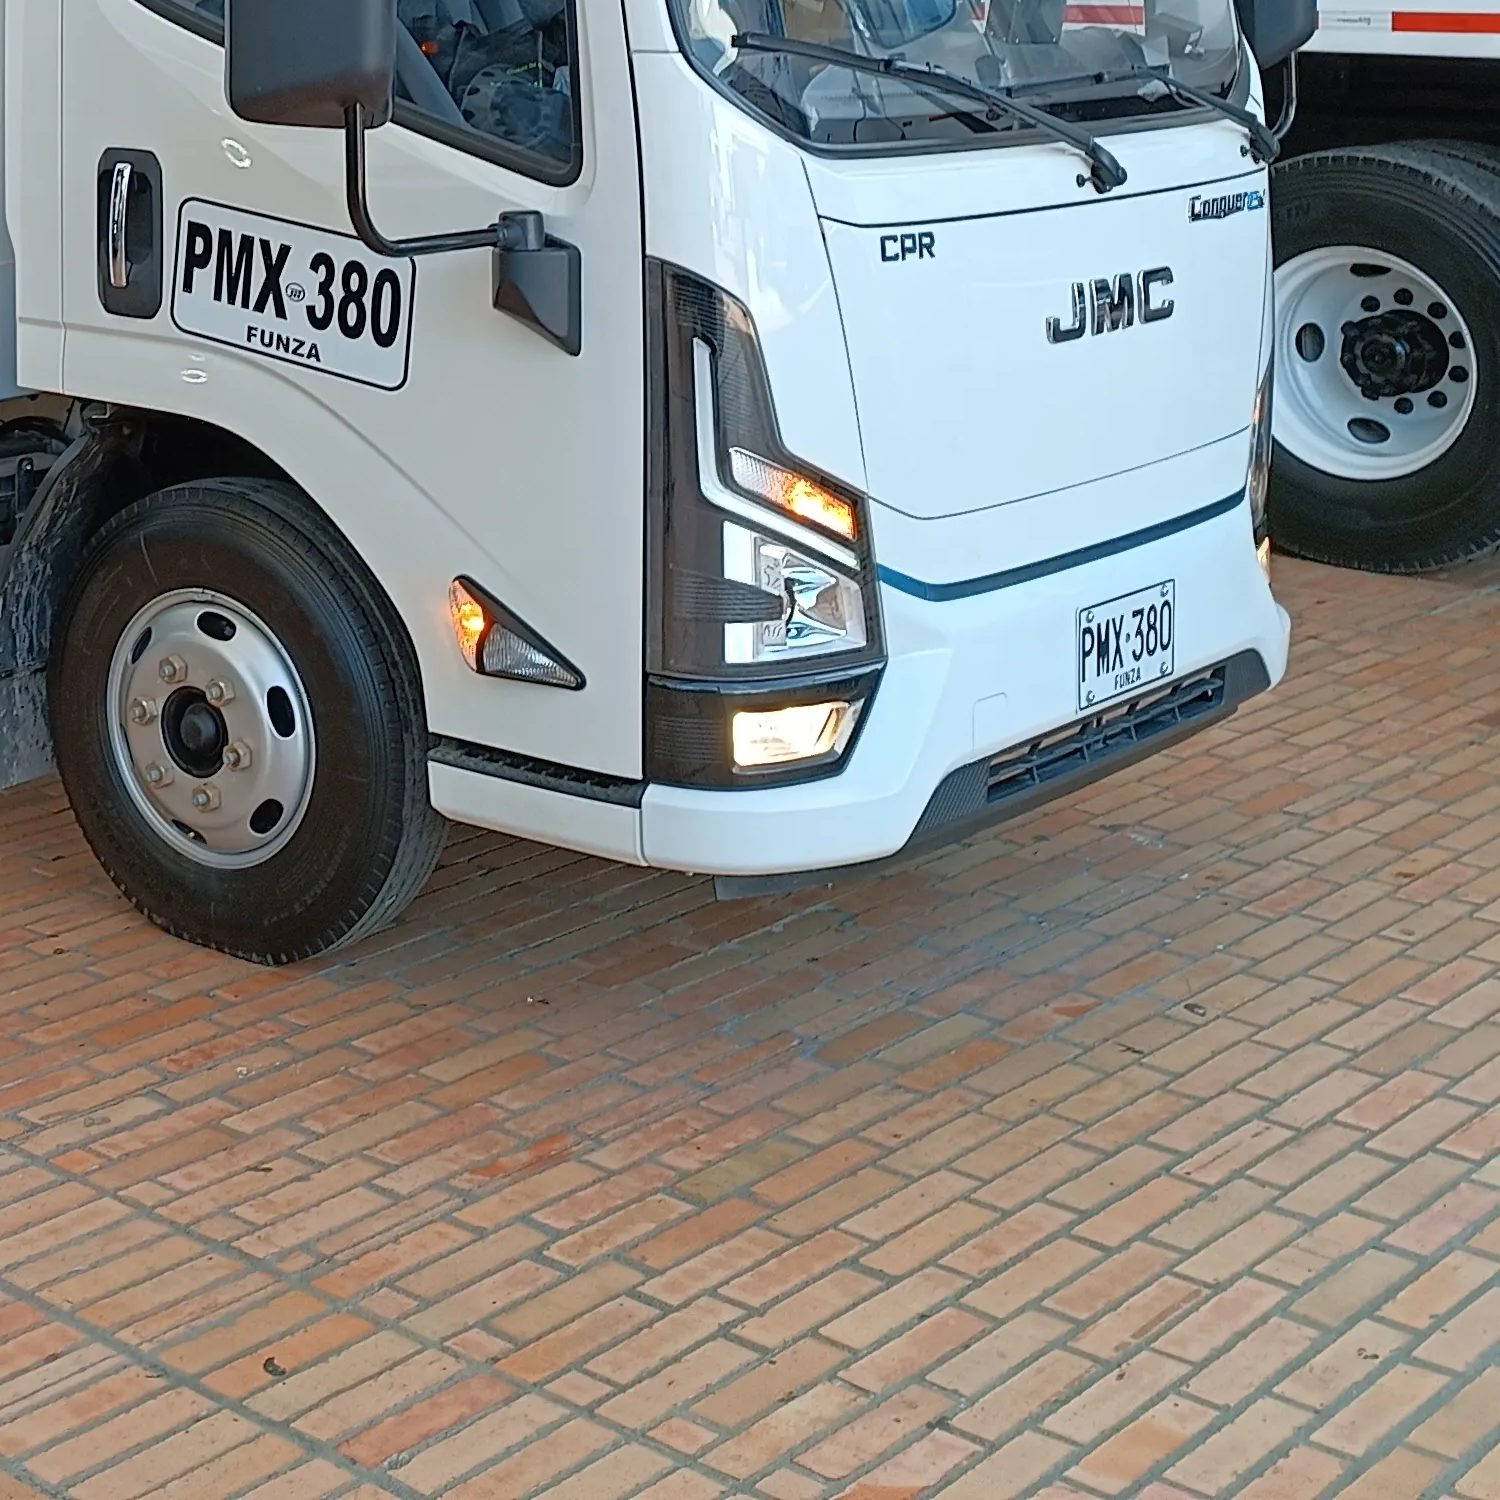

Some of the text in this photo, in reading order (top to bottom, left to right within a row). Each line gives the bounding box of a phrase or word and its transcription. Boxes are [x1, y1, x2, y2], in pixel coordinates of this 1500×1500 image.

[879, 231, 936, 262] CPR
[1045, 265, 1175, 344] JMC
[245, 325, 322, 364] FUNZA
[1114, 666, 1142, 691] FUNZA
